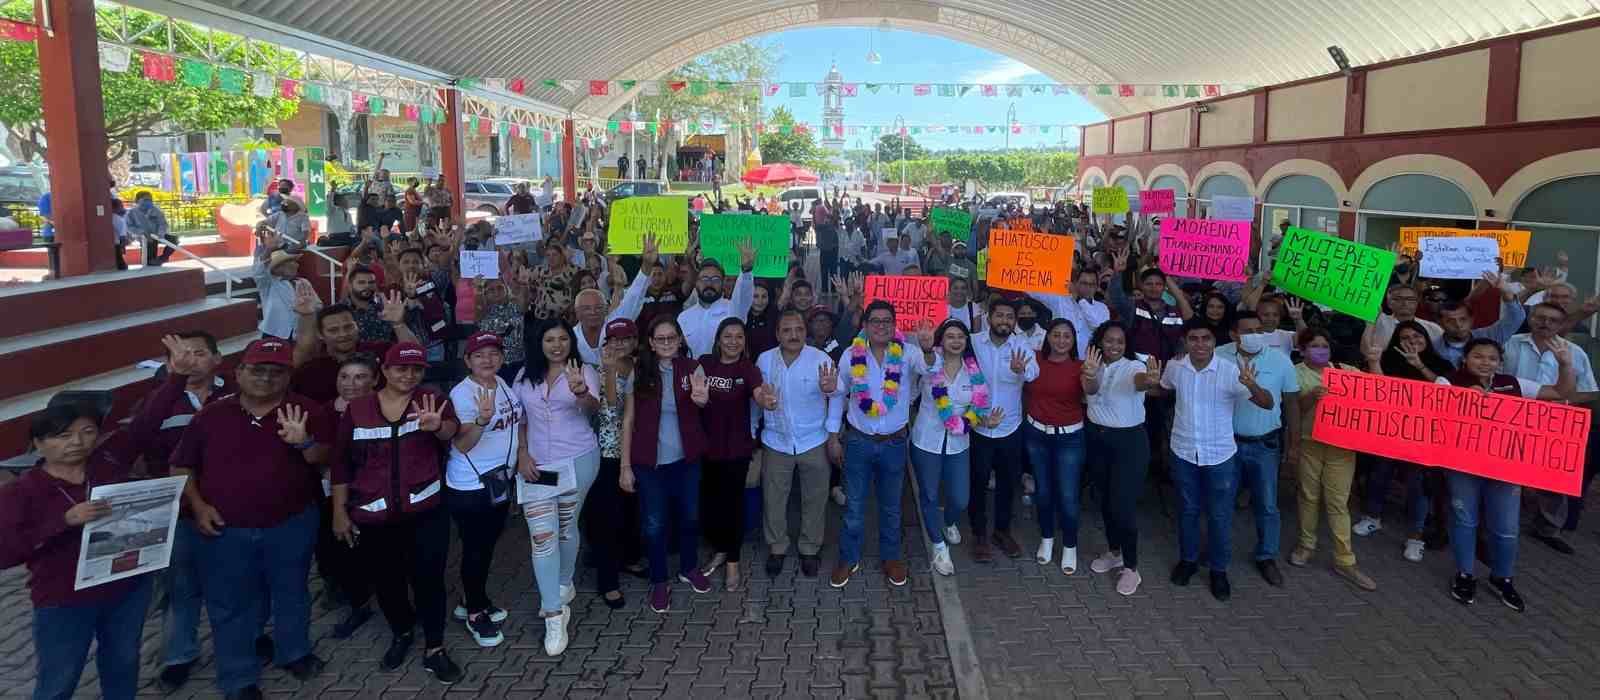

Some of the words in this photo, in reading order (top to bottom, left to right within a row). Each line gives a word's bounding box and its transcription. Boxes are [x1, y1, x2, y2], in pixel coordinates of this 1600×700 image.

[993, 231, 1059, 251] HUATUSCO
[1174, 219, 1240, 240] MORENA
[1016, 251, 1034, 267] ES
[1289, 231, 1380, 268] MUJERES
[1170, 253, 1246, 277] HUATUSCO
[1282, 248, 1304, 268] DE
[1307, 257, 1329, 275] LA
[1336, 263, 1365, 284] 4T
[1361, 269, 1382, 290] EN
[873, 277, 947, 301] HUATUSCO
[1001, 268, 1052, 288] MORENA
[1284, 267, 1371, 307] MARCHA
[892, 300, 939, 317] ESENTE
[1327, 372, 1413, 408] ESTEBAN
[1421, 384, 1505, 422] RAMIREZ
[1511, 397, 1587, 439] ZEPETA
[1321, 401, 1424, 442] HUATUSCO
[1488, 425, 1580, 472] CONTIGO
